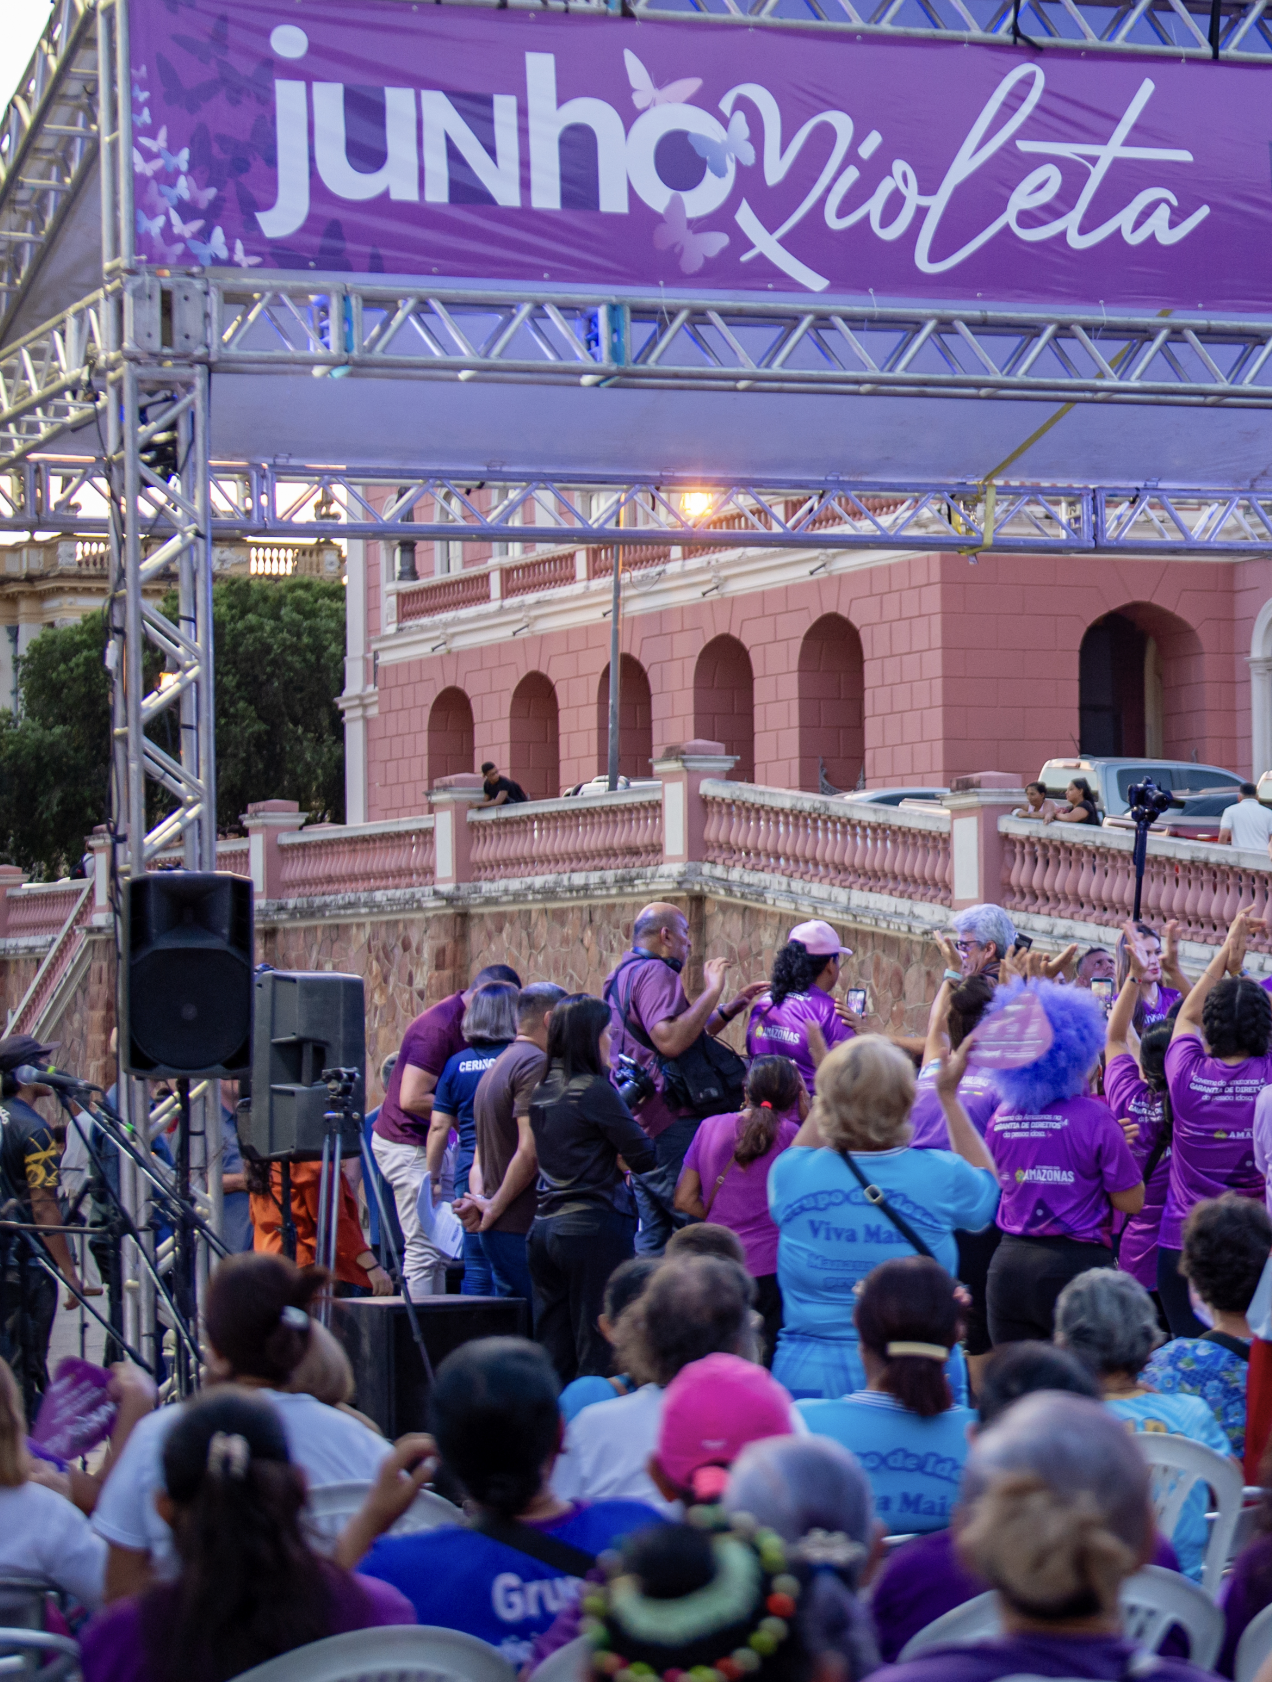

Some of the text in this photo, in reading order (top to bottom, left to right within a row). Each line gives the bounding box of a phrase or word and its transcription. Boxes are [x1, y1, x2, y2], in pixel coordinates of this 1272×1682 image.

[718, 62, 1210, 291] Violeta
[1023, 1168, 1075, 1183] AMAZONAS
[807, 1219, 857, 1243] Viva
[898, 1491, 949, 1517] Mai
